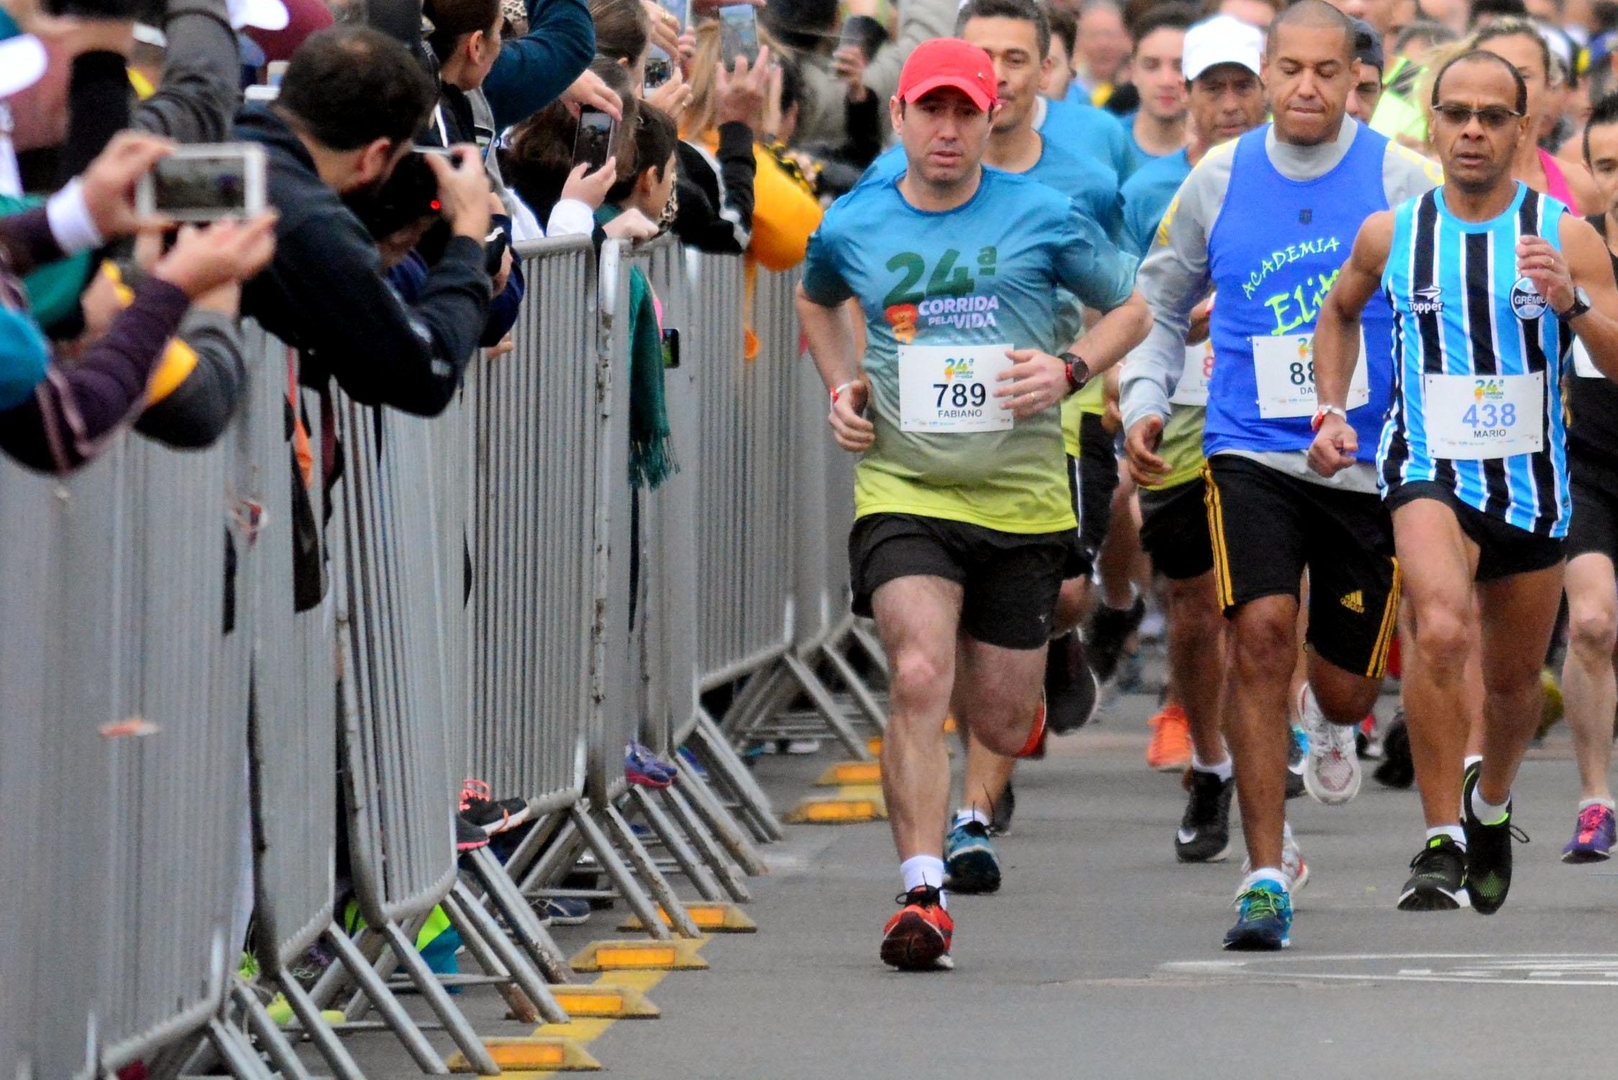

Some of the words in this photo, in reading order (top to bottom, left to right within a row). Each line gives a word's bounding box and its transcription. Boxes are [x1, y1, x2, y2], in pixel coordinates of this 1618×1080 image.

[1241, 236, 1341, 300] ACADEMIA
[918, 295, 1000, 317] CORRIDA
[1407, 300, 1444, 314] Topper
[927, 315, 954, 327] PELA
[953, 311, 998, 330] VIDA
[932, 382, 987, 409] 789
[937, 409, 983, 419] FABIANO
[1461, 402, 1517, 429] 438
[1473, 428, 1507, 439] MARIO
